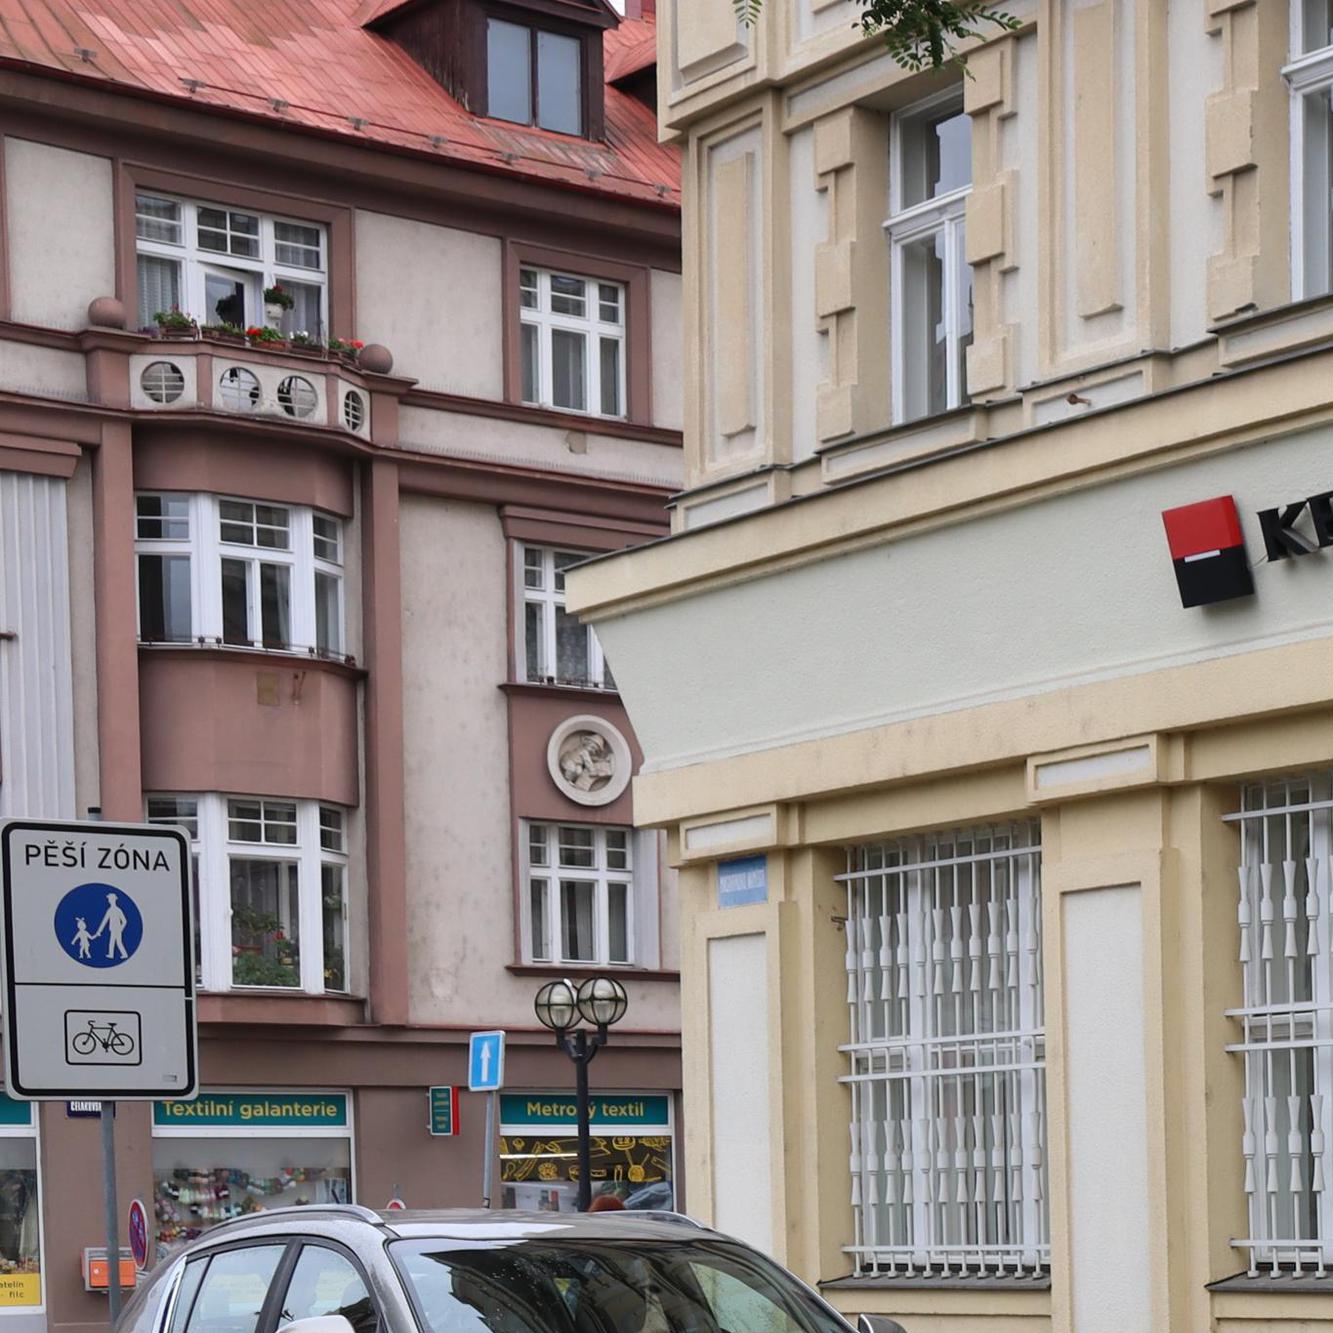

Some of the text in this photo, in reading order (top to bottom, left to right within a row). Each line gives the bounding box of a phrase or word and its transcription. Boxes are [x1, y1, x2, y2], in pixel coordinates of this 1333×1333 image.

[25, 839, 171, 872] PĚŠÍ ZÓNA
[162, 1101, 337, 1120] Textilní galanterie
[527, 1101, 644, 1119] Metroý textil
